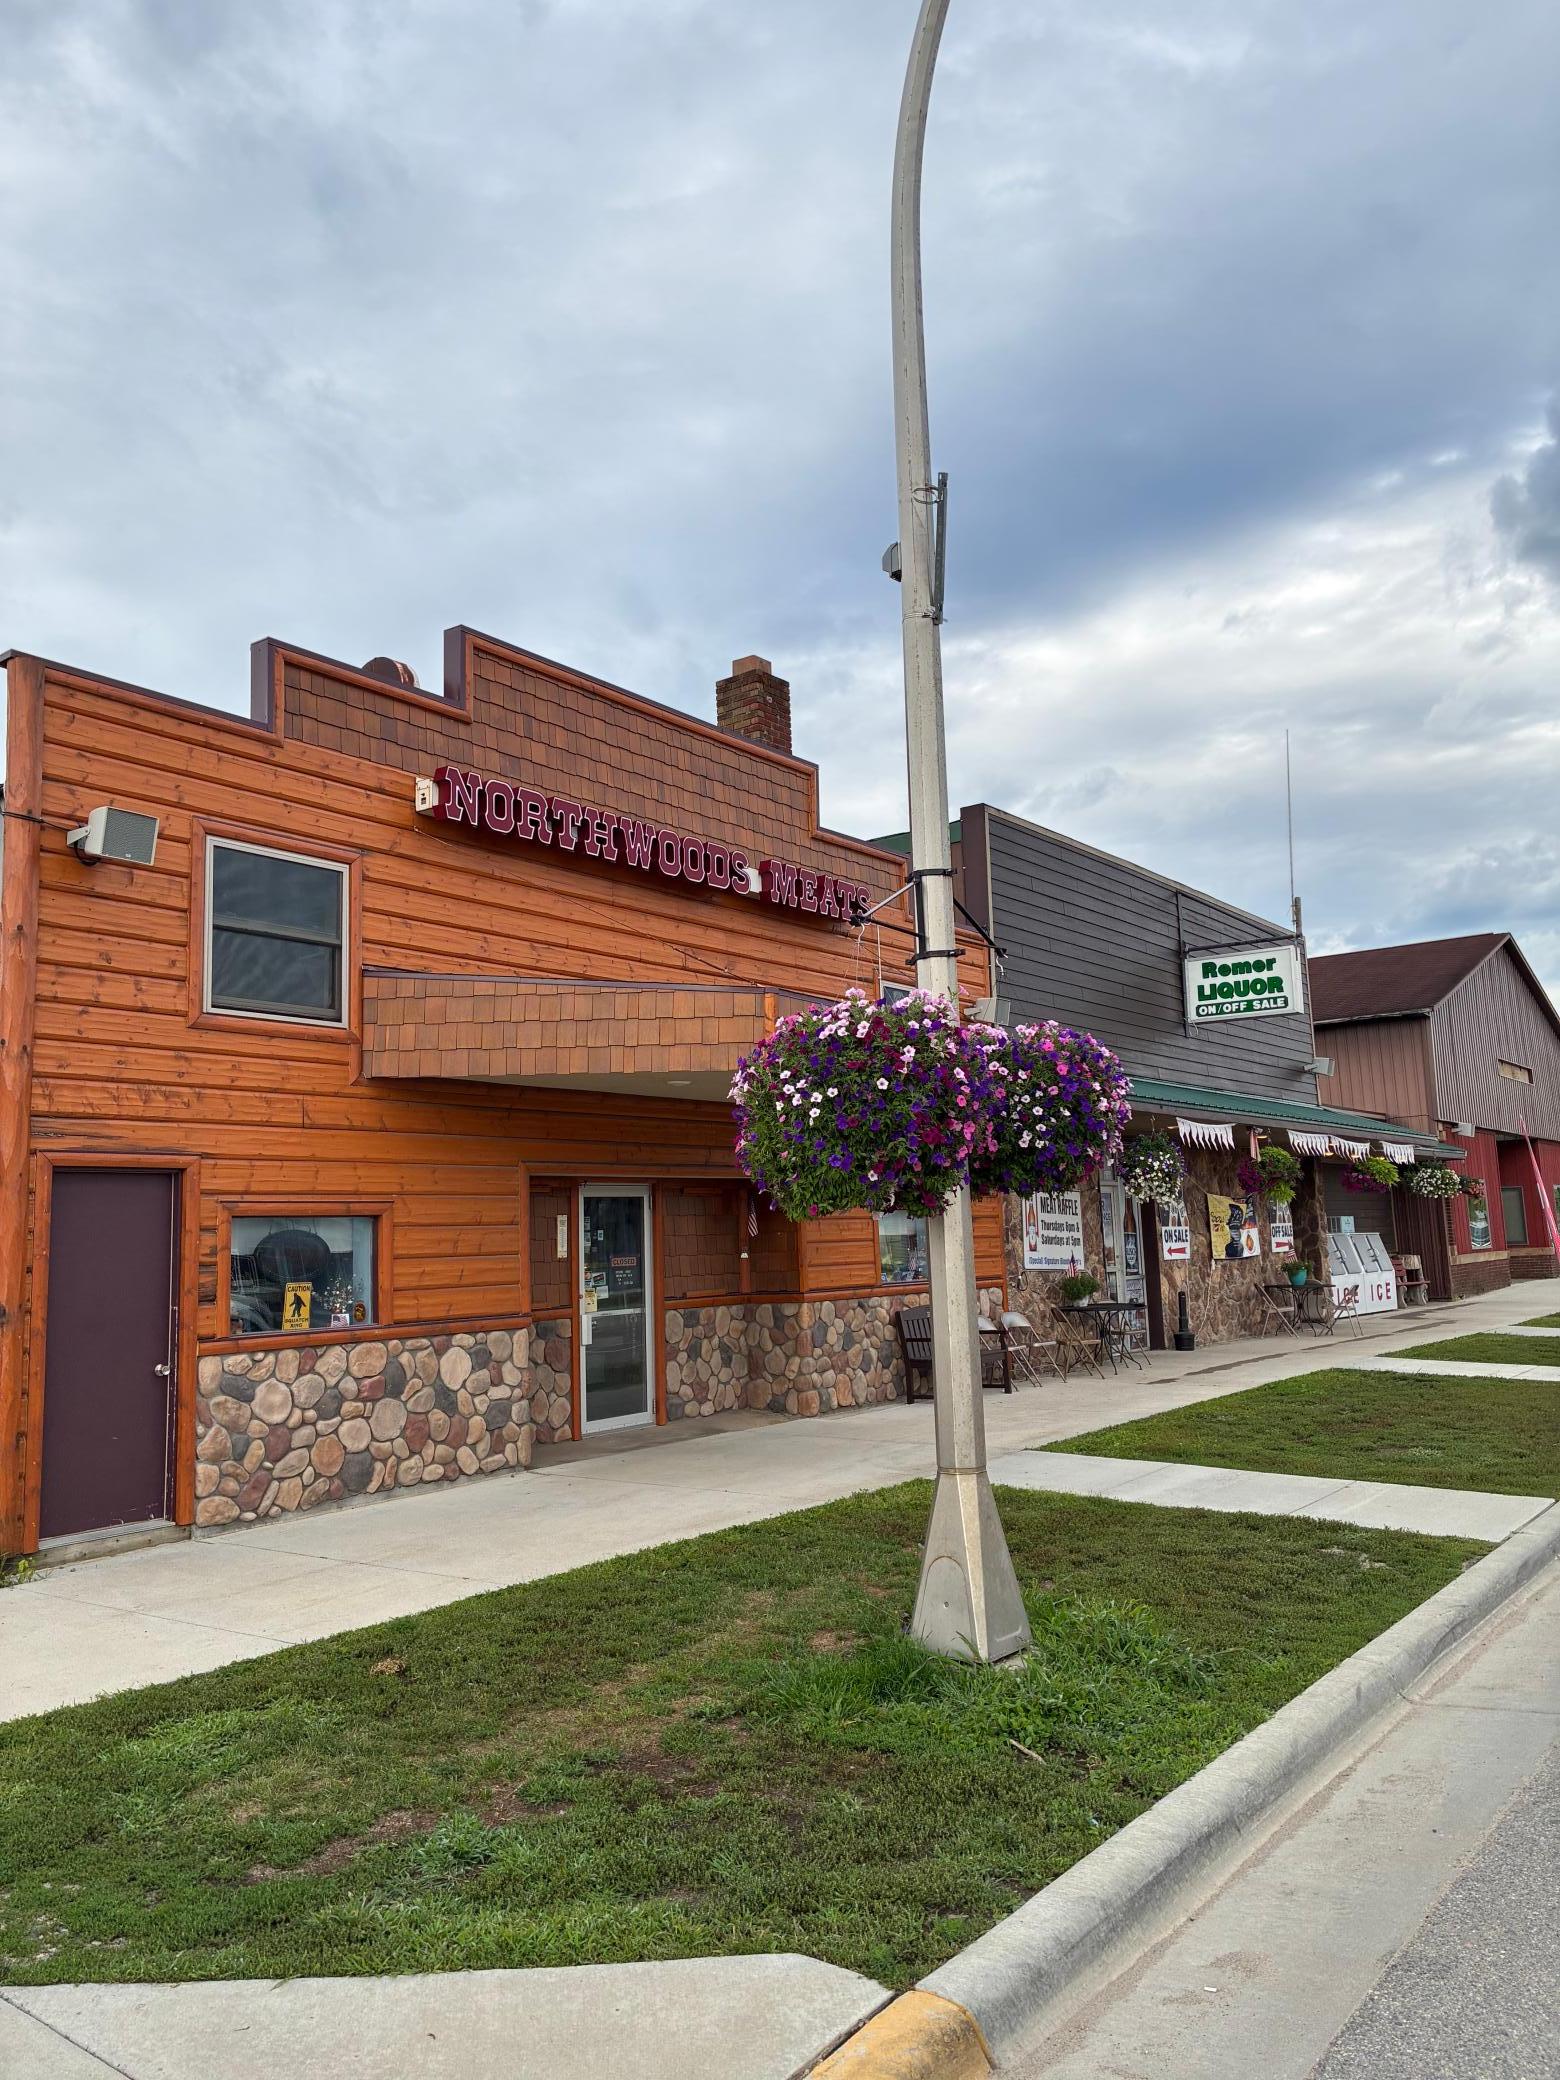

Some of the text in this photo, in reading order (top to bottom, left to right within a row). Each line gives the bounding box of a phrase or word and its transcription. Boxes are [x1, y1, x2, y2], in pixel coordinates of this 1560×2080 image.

[441, 765, 874, 925] NORTHWOODS MEATS
[1201, 958, 1277, 979] Romer
[1197, 976, 1284, 1001] LIQUOR
[1198, 998, 1286, 1016] ON/OFF SALE
[1040, 1196, 1057, 1215] MEAT
[1057, 1198, 1079, 1216] RAFFLE
[1041, 1220, 1065, 1233] Thursdays
[1271, 1225, 1293, 1238] OFF SALE
[1041, 1234, 1065, 1246] Saturdays
[1163, 1229, 1188, 1243] ON SALE
[1337, 1286, 1359, 1304] ICE
[1371, 1281, 1391, 1301] ICE
